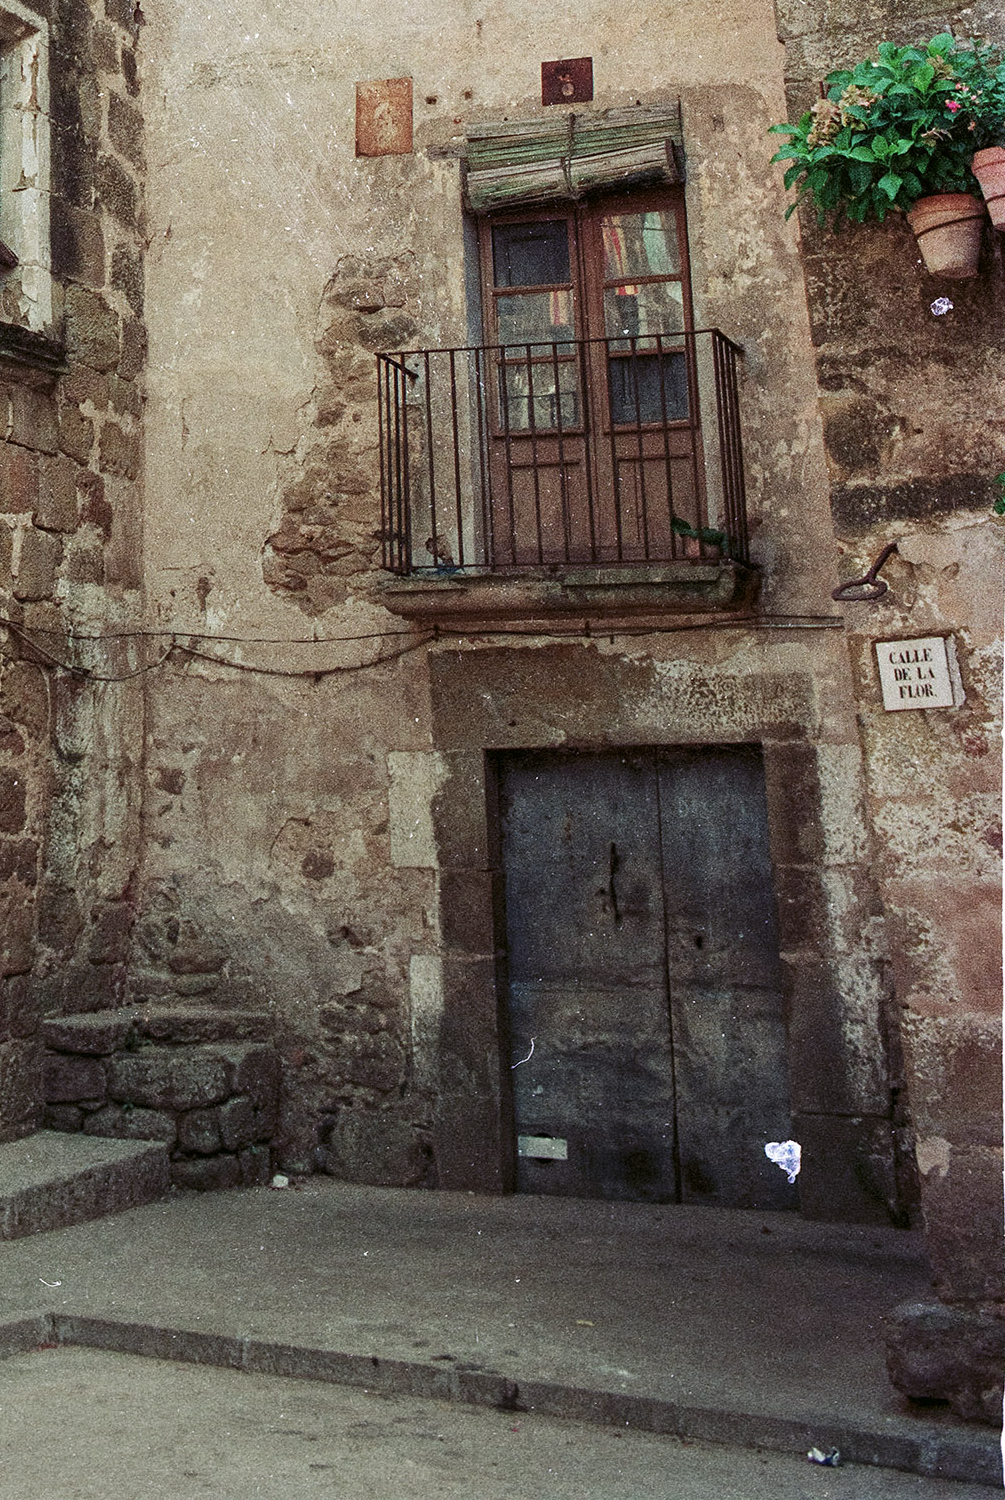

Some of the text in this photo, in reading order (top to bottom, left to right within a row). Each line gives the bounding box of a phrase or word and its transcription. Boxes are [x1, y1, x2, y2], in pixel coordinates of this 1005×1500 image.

[889, 648, 932, 664] CALLE
[894, 667, 935, 681] DE LA
